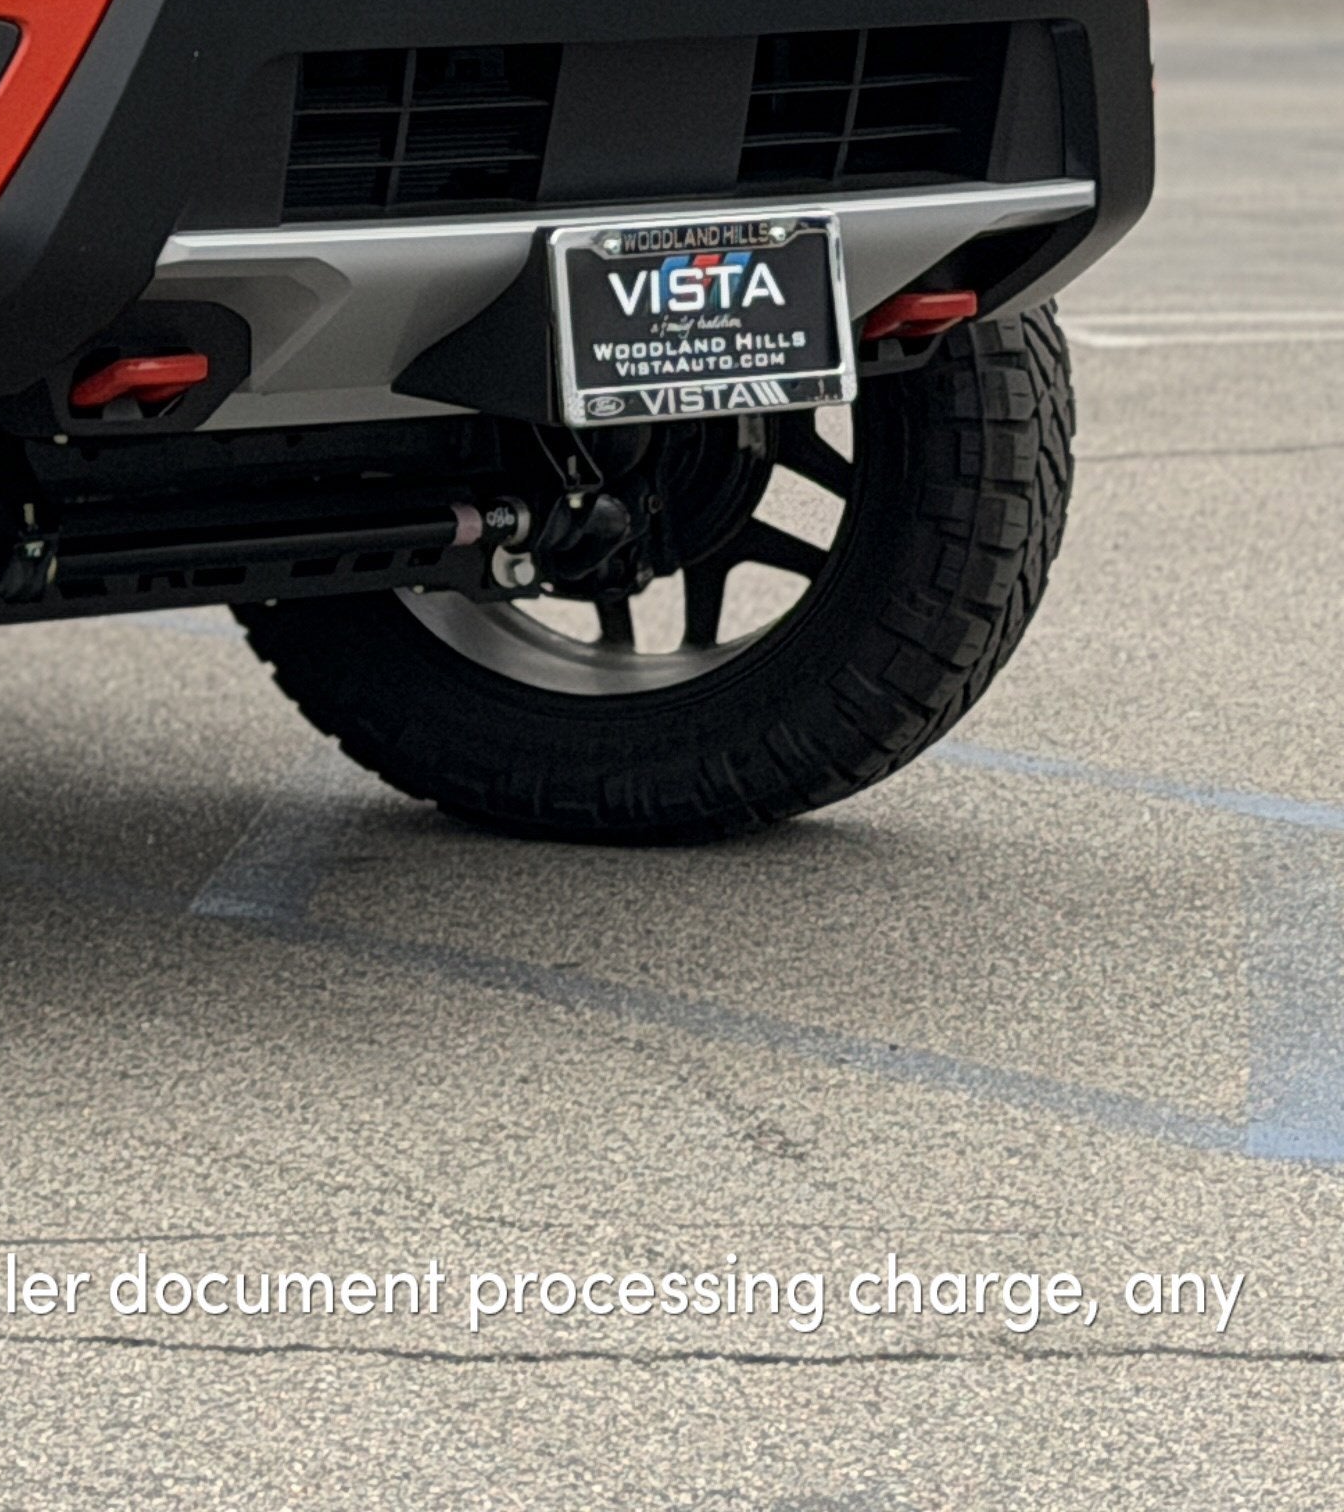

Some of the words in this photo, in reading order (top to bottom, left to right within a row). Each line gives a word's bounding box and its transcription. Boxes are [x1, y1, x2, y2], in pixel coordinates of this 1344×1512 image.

[623, 225, 720, 252] WOODLAND
[723, 222, 770, 245] HILLS
[608, 262, 786, 316] VISTA
[593, 337, 726, 362] WOODLAND
[735, 330, 806, 351] HILLS
[640, 384, 756, 415] VISTA
